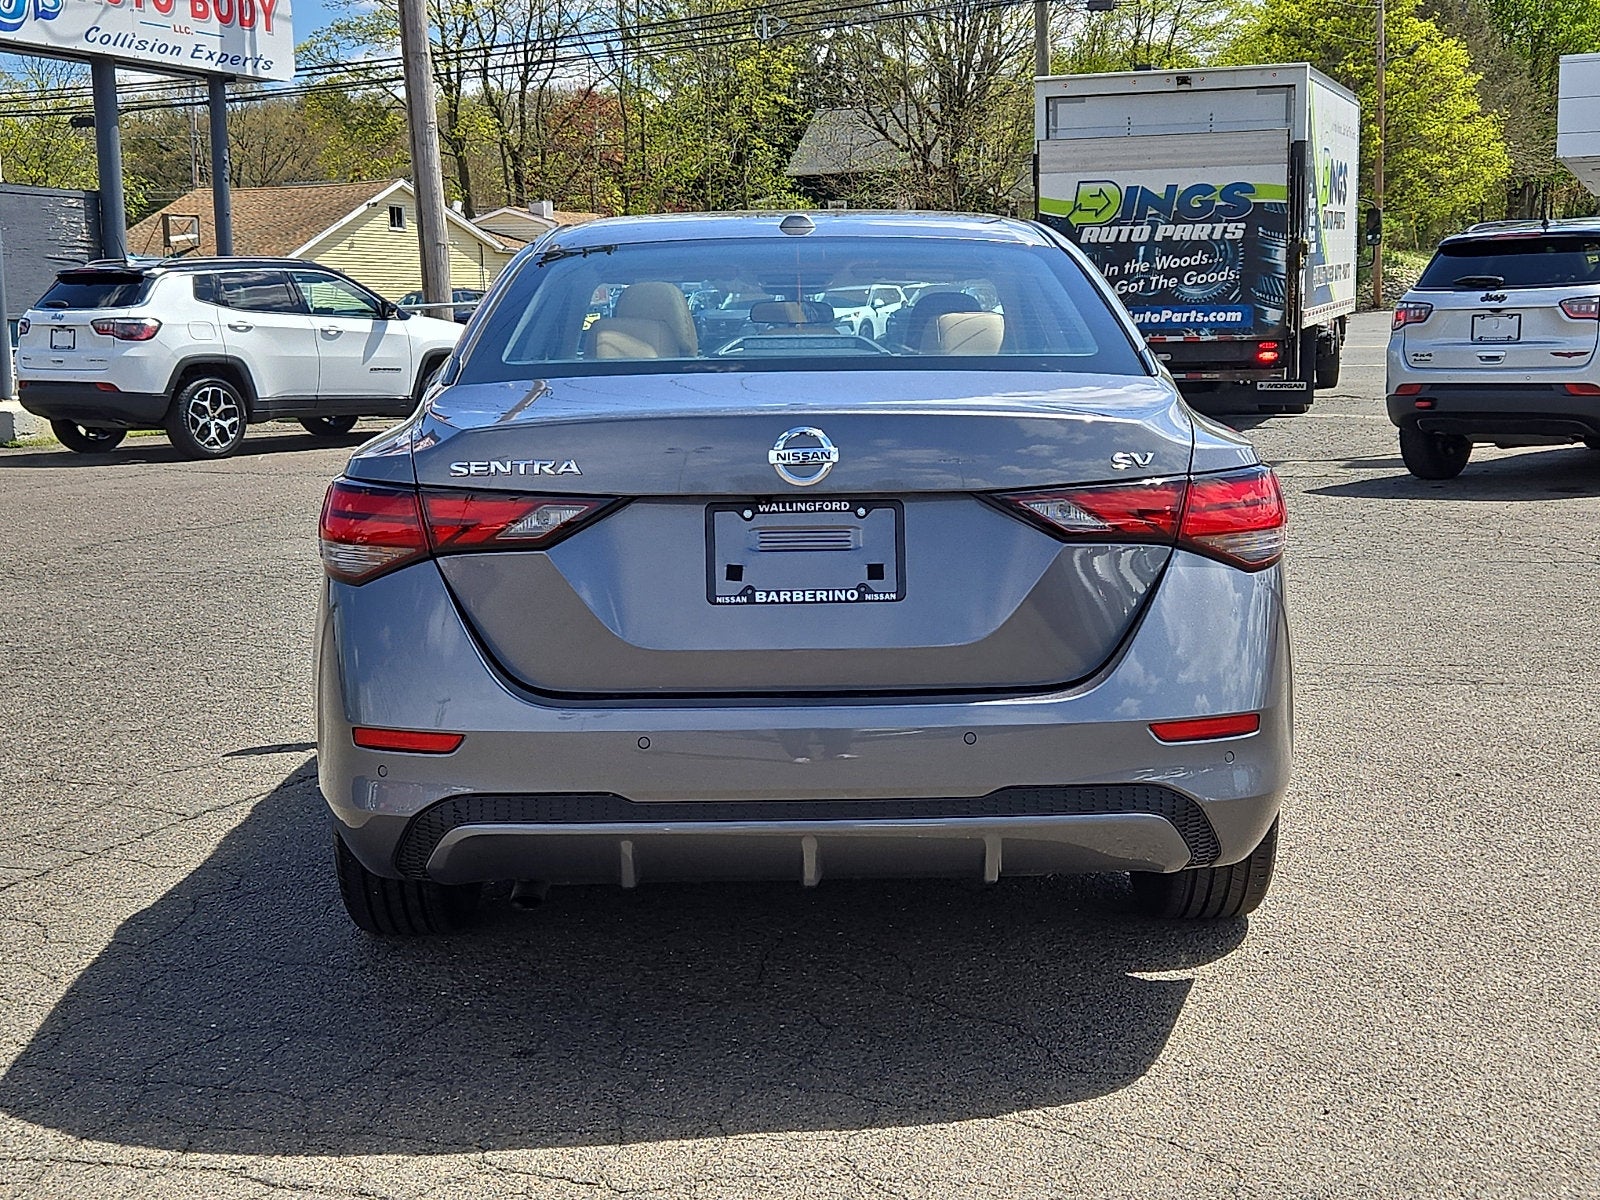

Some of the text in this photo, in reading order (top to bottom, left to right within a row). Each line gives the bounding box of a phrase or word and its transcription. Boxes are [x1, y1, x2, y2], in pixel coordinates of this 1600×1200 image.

[173, 24, 194, 35] LLC.
[84, 26, 274, 71] Collision Experts
[1068, 180, 1256, 227] DINGS
[1080, 222, 1247, 243] AUTO PARTS
[1104, 250, 1224, 277] In the Woods...
[1114, 279, 1146, 295] Got
[1150, 276, 1179, 290] The
[776, 451, 831, 461] NISSAN
[1111, 451, 1155, 470] SV
[450, 460, 583, 477] SENTRA
[758, 501, 850, 512] WALLINGFORD
[716, 595, 747, 603] NISSAN
[755, 590, 859, 602] BARBERINO
